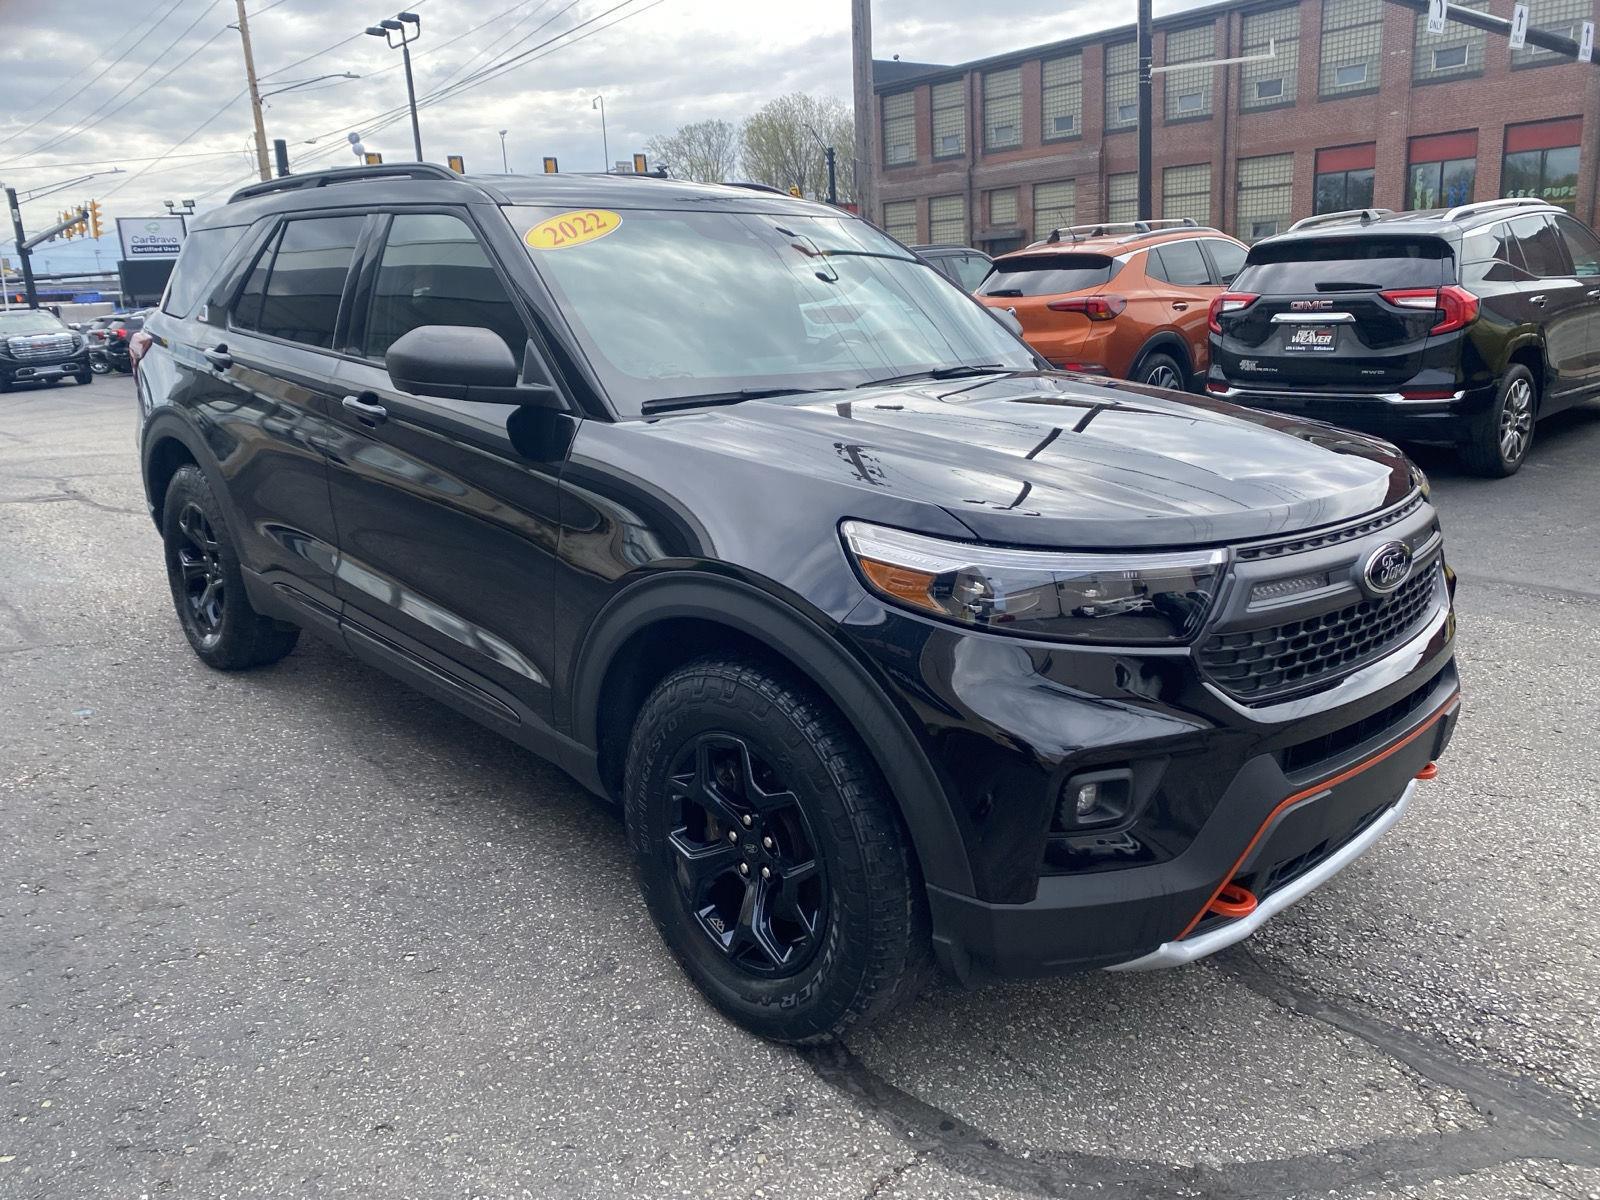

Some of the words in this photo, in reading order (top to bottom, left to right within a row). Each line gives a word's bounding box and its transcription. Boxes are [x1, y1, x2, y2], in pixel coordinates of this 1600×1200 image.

[1429, 20, 1443, 30] ONLY
[543, 212, 607, 246] 2022
[131, 235, 177, 244] CarBravo
[1290, 300, 1333, 310] GMC
[1291, 335, 1332, 343] WEAVER
[1297, 330, 1316, 338] RICK
[1381, 552, 1407, 583] Ford
